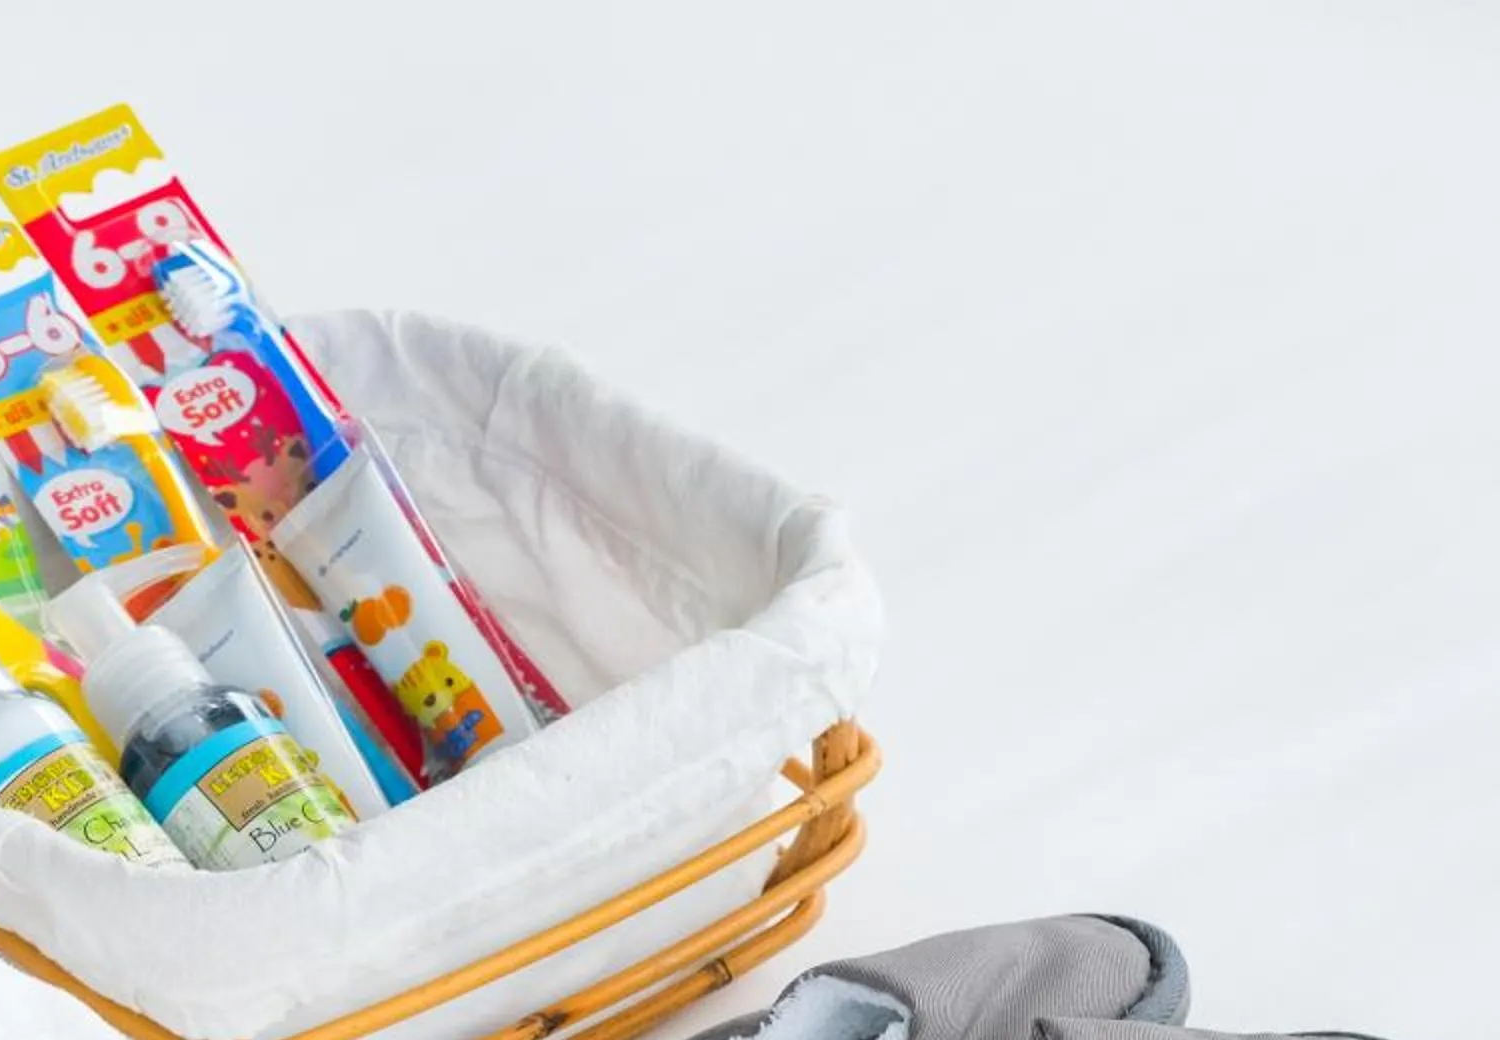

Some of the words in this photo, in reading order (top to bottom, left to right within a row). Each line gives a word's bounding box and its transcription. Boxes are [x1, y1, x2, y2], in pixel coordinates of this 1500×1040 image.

[173, 377, 227, 405] Extra
[182, 388, 245, 428] Soft
[51, 481, 104, 506] Extra
[59, 493, 123, 531] Soft
[249, 816, 302, 853] Blue
